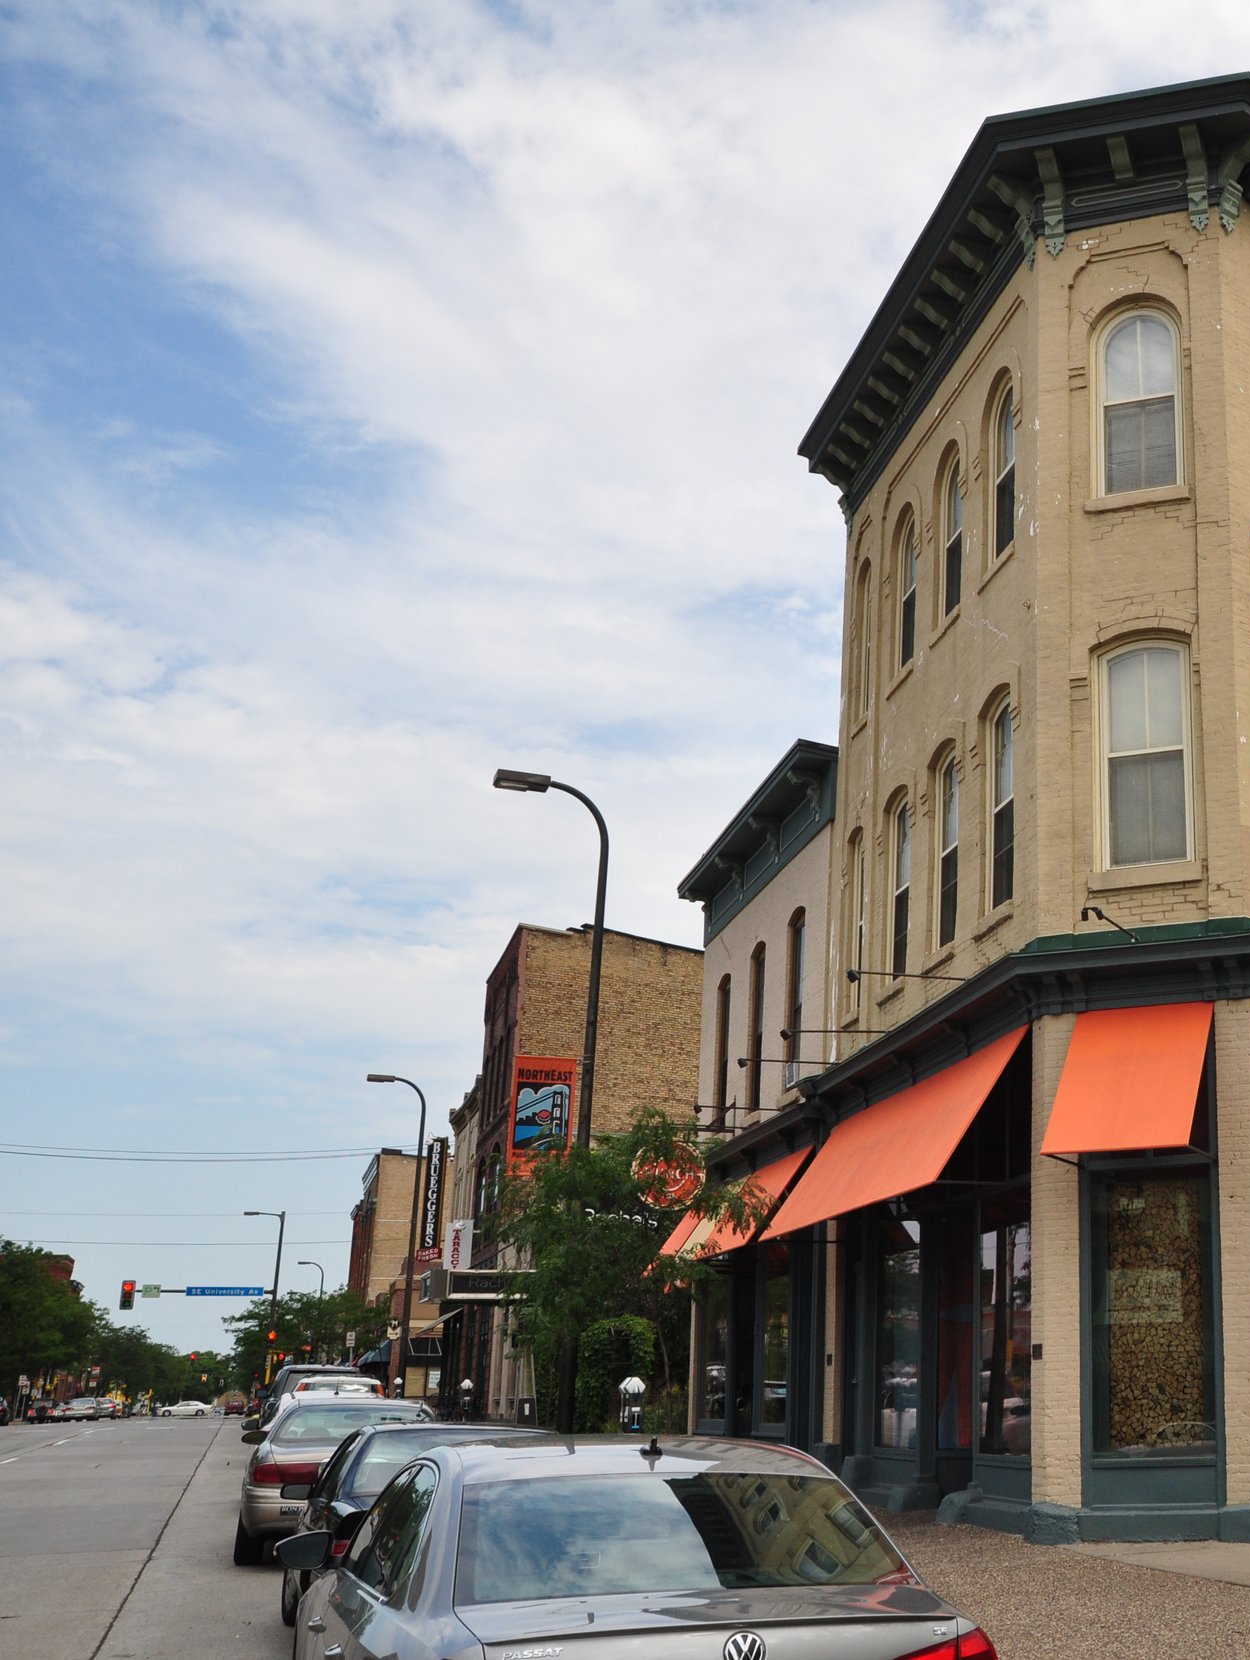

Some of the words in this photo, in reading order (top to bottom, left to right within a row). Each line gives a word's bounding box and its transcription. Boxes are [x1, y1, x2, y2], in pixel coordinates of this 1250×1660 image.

[517, 1067, 573, 1083] NORTHEAST
[424, 1141, 441, 1247] BRUEGGERS
[205, 1288, 244, 1297] University
[501, 1647, 563, 1660] PASSAT
